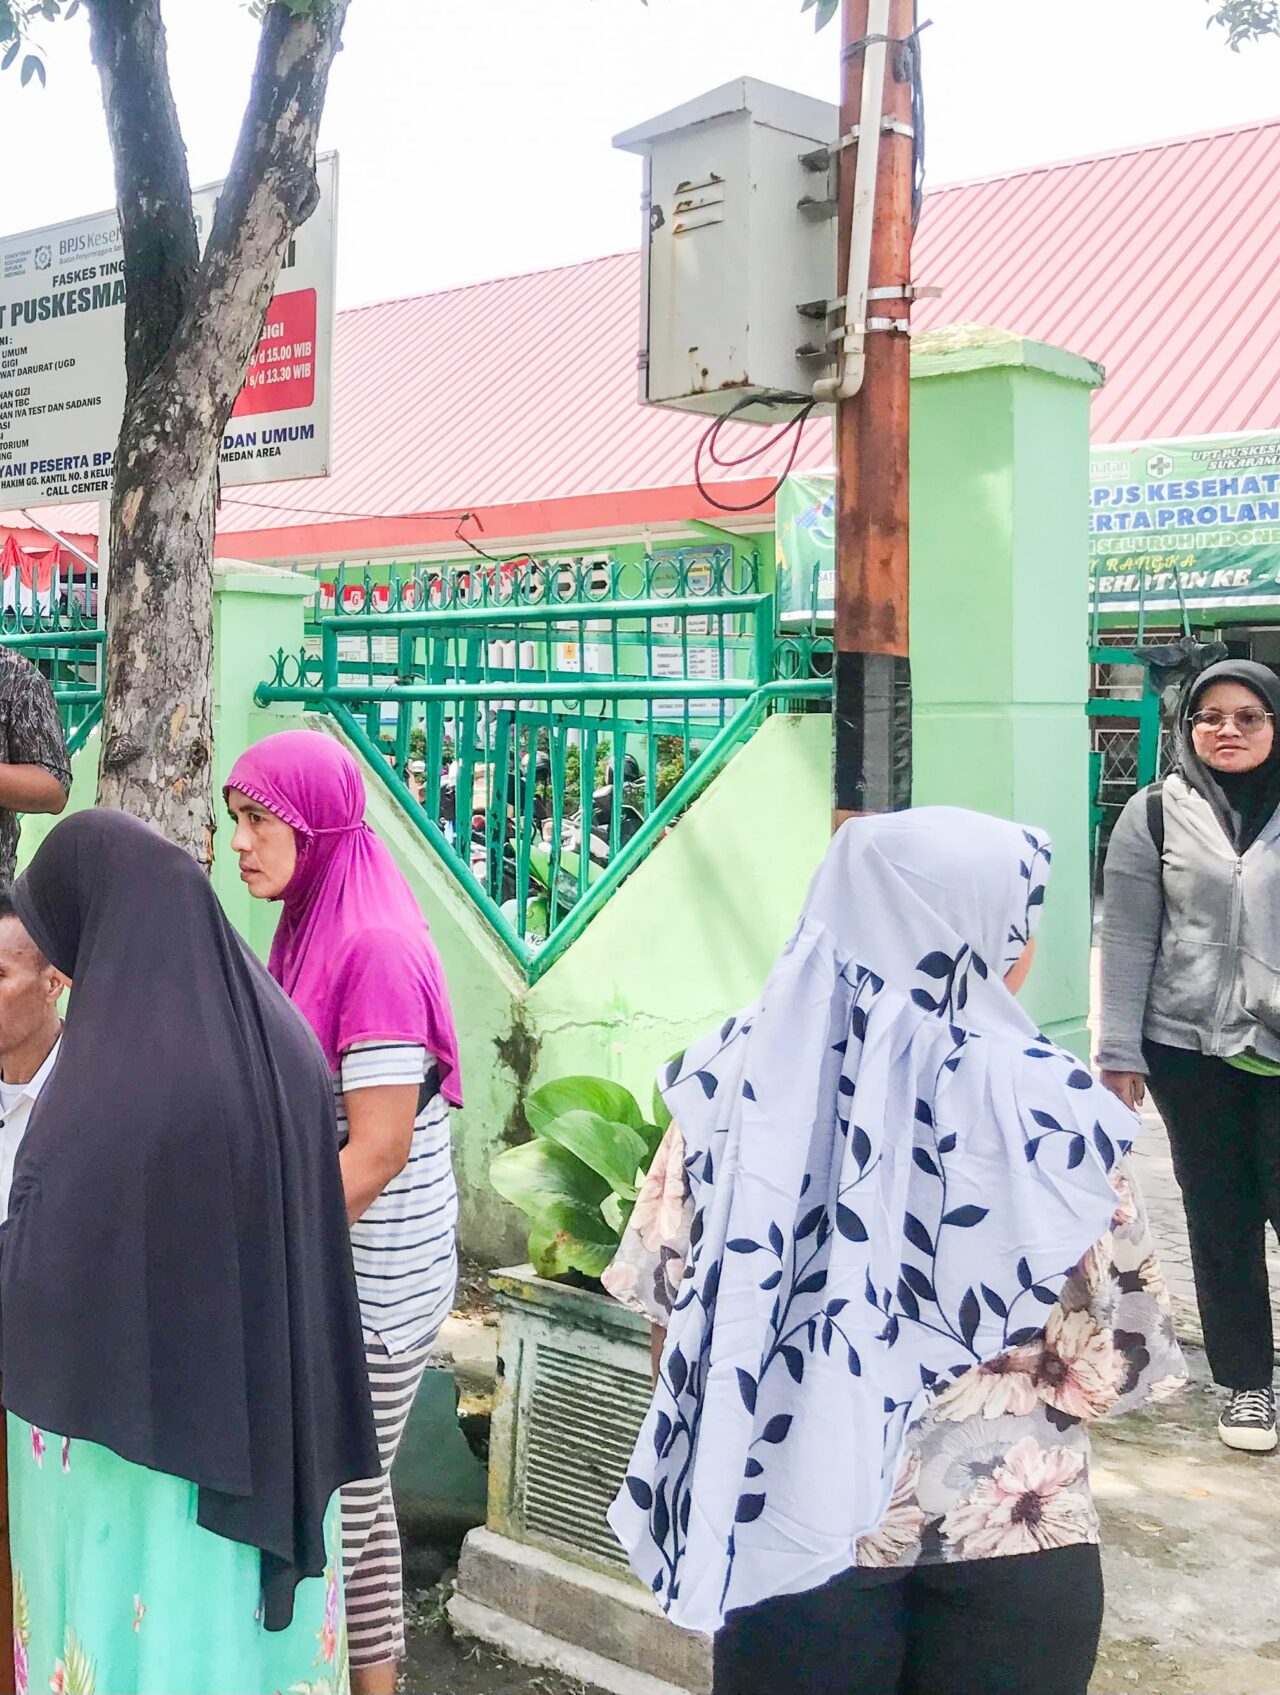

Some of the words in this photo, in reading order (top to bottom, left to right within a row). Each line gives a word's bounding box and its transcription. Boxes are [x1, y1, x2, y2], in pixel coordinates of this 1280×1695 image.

[59, 234, 86, 256] BPJS
[52, 266, 97, 288] FASKES
[99, 259, 125, 277] TING
[10, 279, 127, 327] PUSKESMA
[2, 346, 28, 359] UMUM
[250, 349, 266, 369] s/d
[266, 345, 292, 363] 15.00
[293, 341, 312, 358] WIB
[1, 358, 18, 370] GIGI
[17, 361, 53, 377] DARURAT
[54, 357, 76, 371] (UGD
[249, 369, 265, 389] s/d
[266, 366, 291, 384] 13.30
[293, 362, 311, 380] WIB
[15, 386, 31, 398] GIZI
[15, 397, 30, 408] TBC
[14, 408, 27, 418] IVA
[28, 405, 46, 416] TEST
[47, 402, 64, 413] DAN
[65, 396, 102, 410] SADANIS
[30, 453, 89, 475] PESERTA
[92, 451, 114, 466] BP
[223, 431, 257, 450] DAN
[262, 424, 315, 445] UMUM
[1192, 449, 1221, 461] UPT
[1221, 443, 1280, 459] PUSKES
[0, 478, 25, 489] HAKIM
[26, 477, 39, 487] GG.
[40, 474, 67, 485] KANTIL
[68, 471, 82, 482] NO.
[83, 470, 89, 480] 8
[90, 467, 114, 478] KELU
[220, 449, 254, 463] MEDAN
[255, 446, 282, 458] AREA
[1090, 460, 1128, 474] hatan
[1207, 455, 1280, 471] SUKARAM
[46, 486, 70, 497] CALL
[71, 480, 109, 494] CENTER
[1089, 485, 1141, 507] PJS
[1146, 473, 1280, 503] KESEHAT
[1157, 501, 1280, 528] PROLAN
[1097, 533, 1195, 555] SELURUH
[1196, 528, 1280, 548] INDONE
[1106, 554, 1197, 574] RANGKA
[1210, 568, 1252, 588] KE
